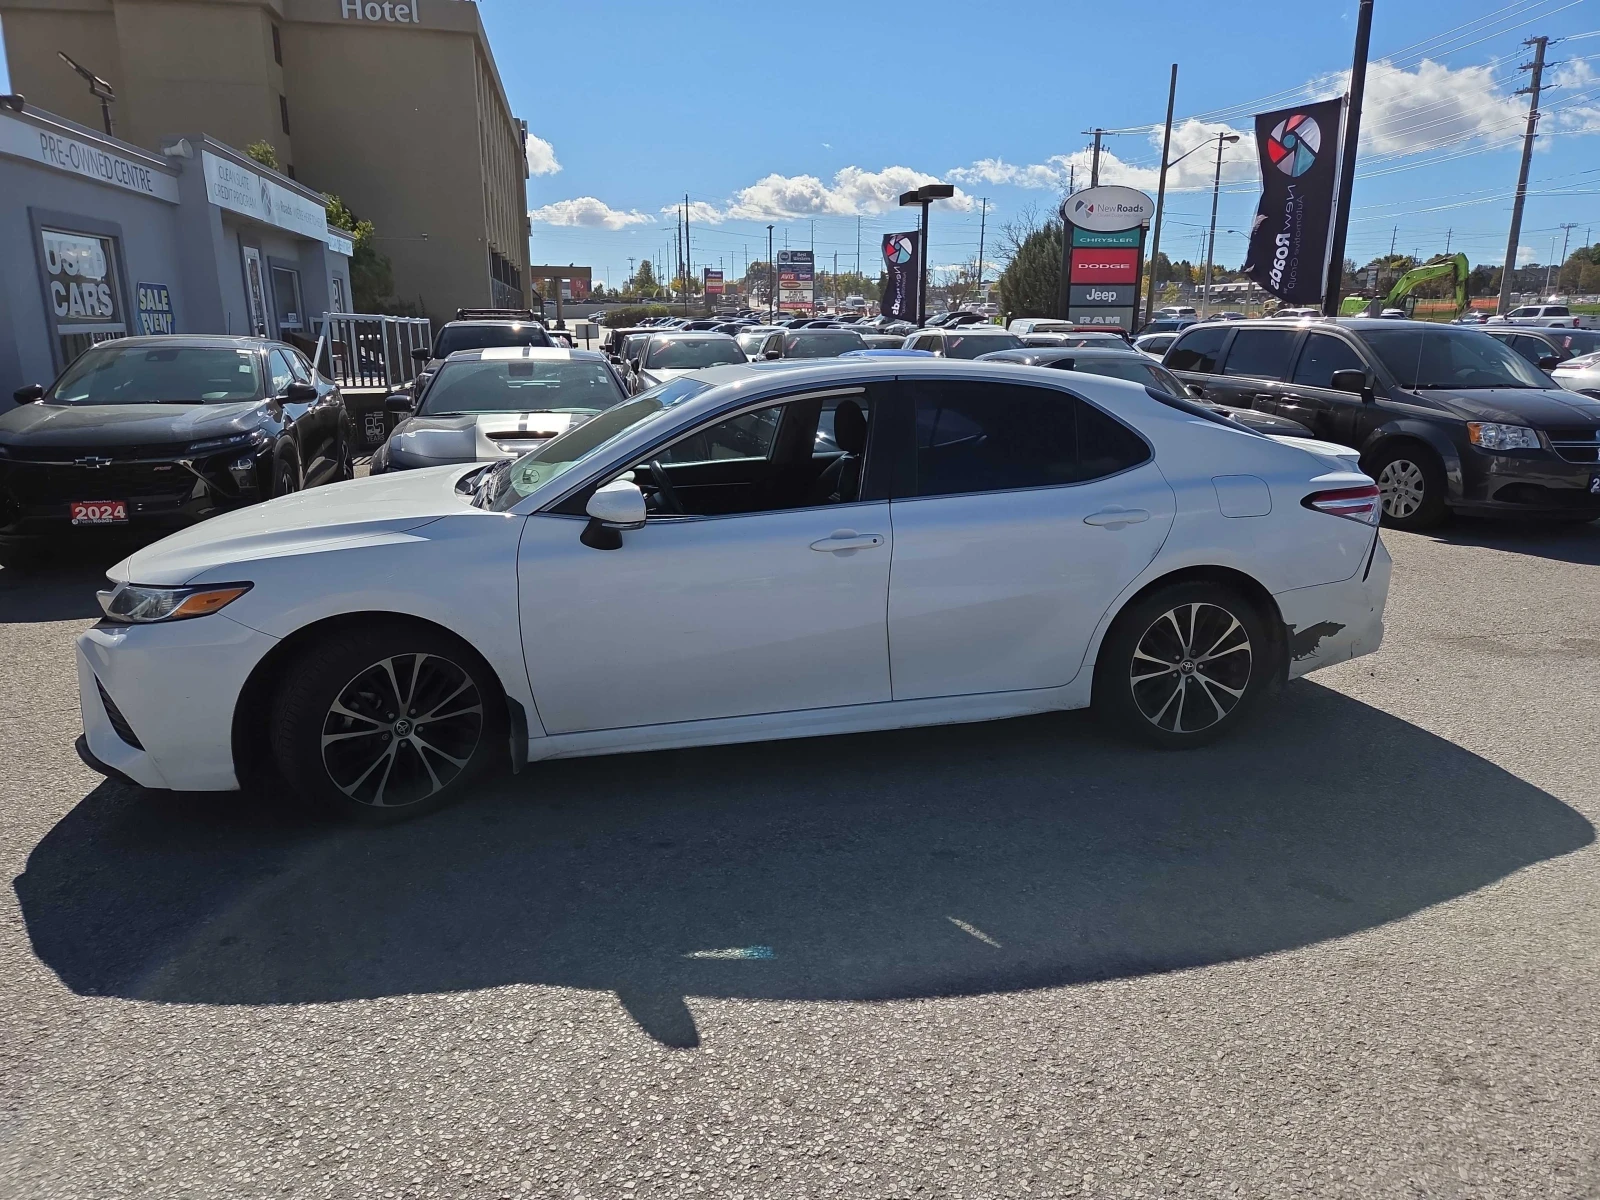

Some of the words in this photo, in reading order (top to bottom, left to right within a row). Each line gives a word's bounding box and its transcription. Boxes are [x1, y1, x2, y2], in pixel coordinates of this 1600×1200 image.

[341, 0, 420, 23] Hotel
[40, 132, 114, 180] PRE-OWNED
[115, 160, 153, 192] CENTRE
[218, 166, 236, 184] CLEAN
[235, 173, 250, 190] SLATE
[214, 183, 233, 202] CREDIT
[44, 239, 107, 280] USED
[50, 281, 114, 317] CARS
[140, 288, 169, 311] SALE
[1086, 288, 1117, 302] Jeep
[141, 313, 172, 335] EVENT
[1079, 316, 1120, 324] RAM
[74, 505, 126, 520] 2024
